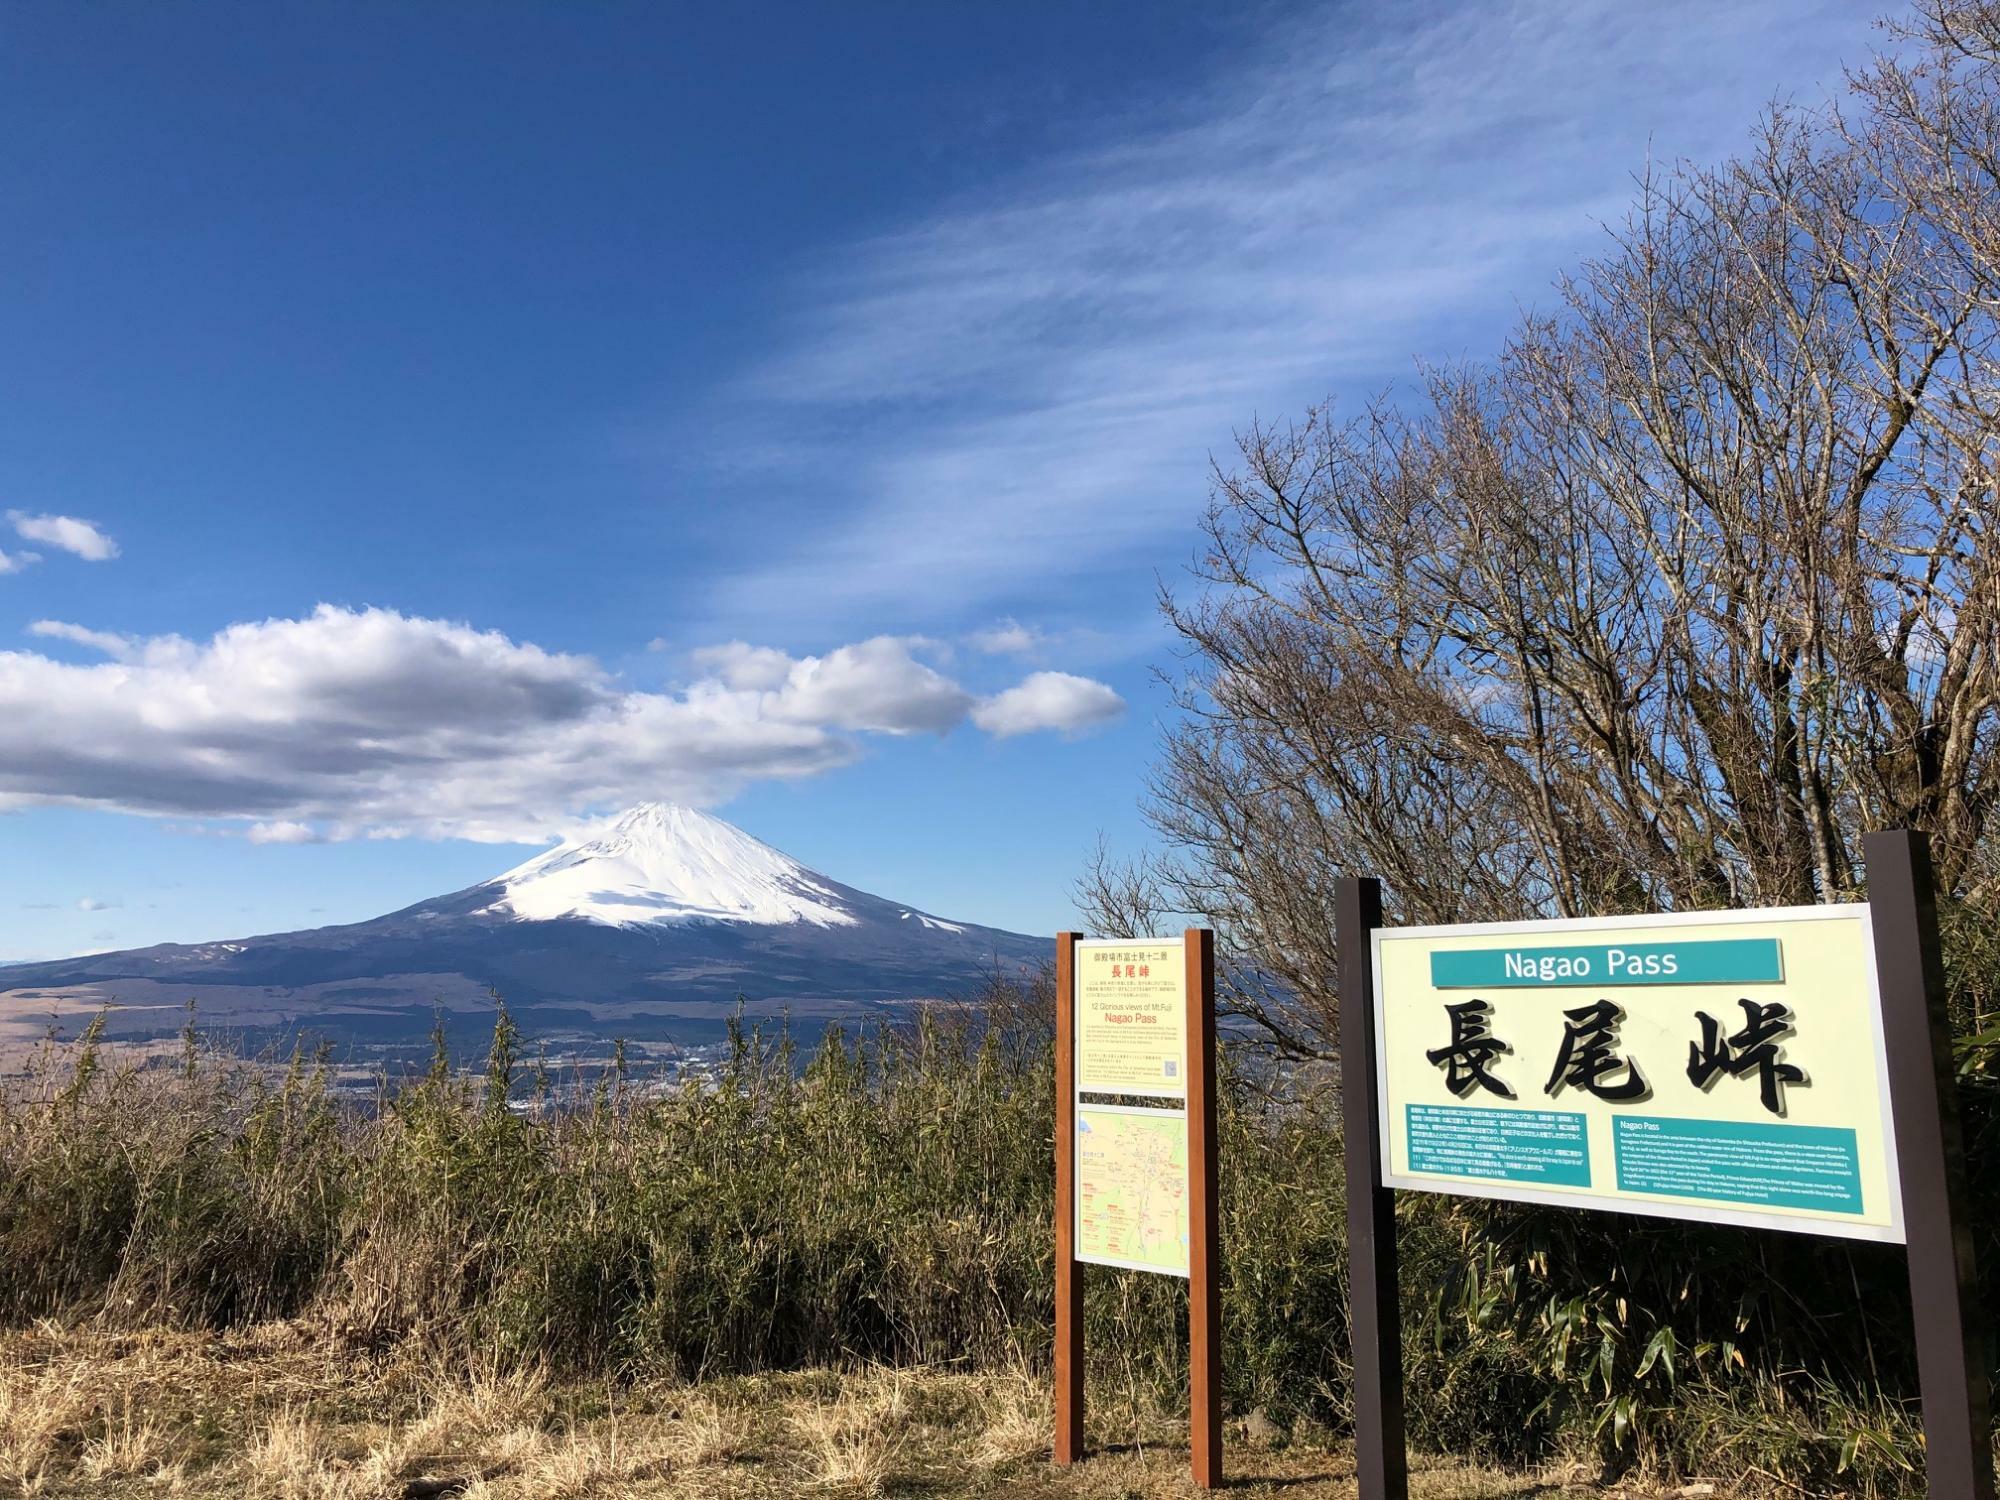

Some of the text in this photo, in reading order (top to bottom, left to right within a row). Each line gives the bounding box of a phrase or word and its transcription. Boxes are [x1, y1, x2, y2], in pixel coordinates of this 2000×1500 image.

[1112, 964, 1150, 978] 長尾峠
[1505, 950, 1678, 981] Nagao Pass
[1144, 1003, 1150, 1011] of
[1152, 1004, 1172, 1012] Mt.Fuji
[1105, 1012, 1157, 1024] Nagao Pass
[1426, 999, 1810, 1116] 長尾峠
[1620, 1120, 1659, 1130] Nagao Pass
